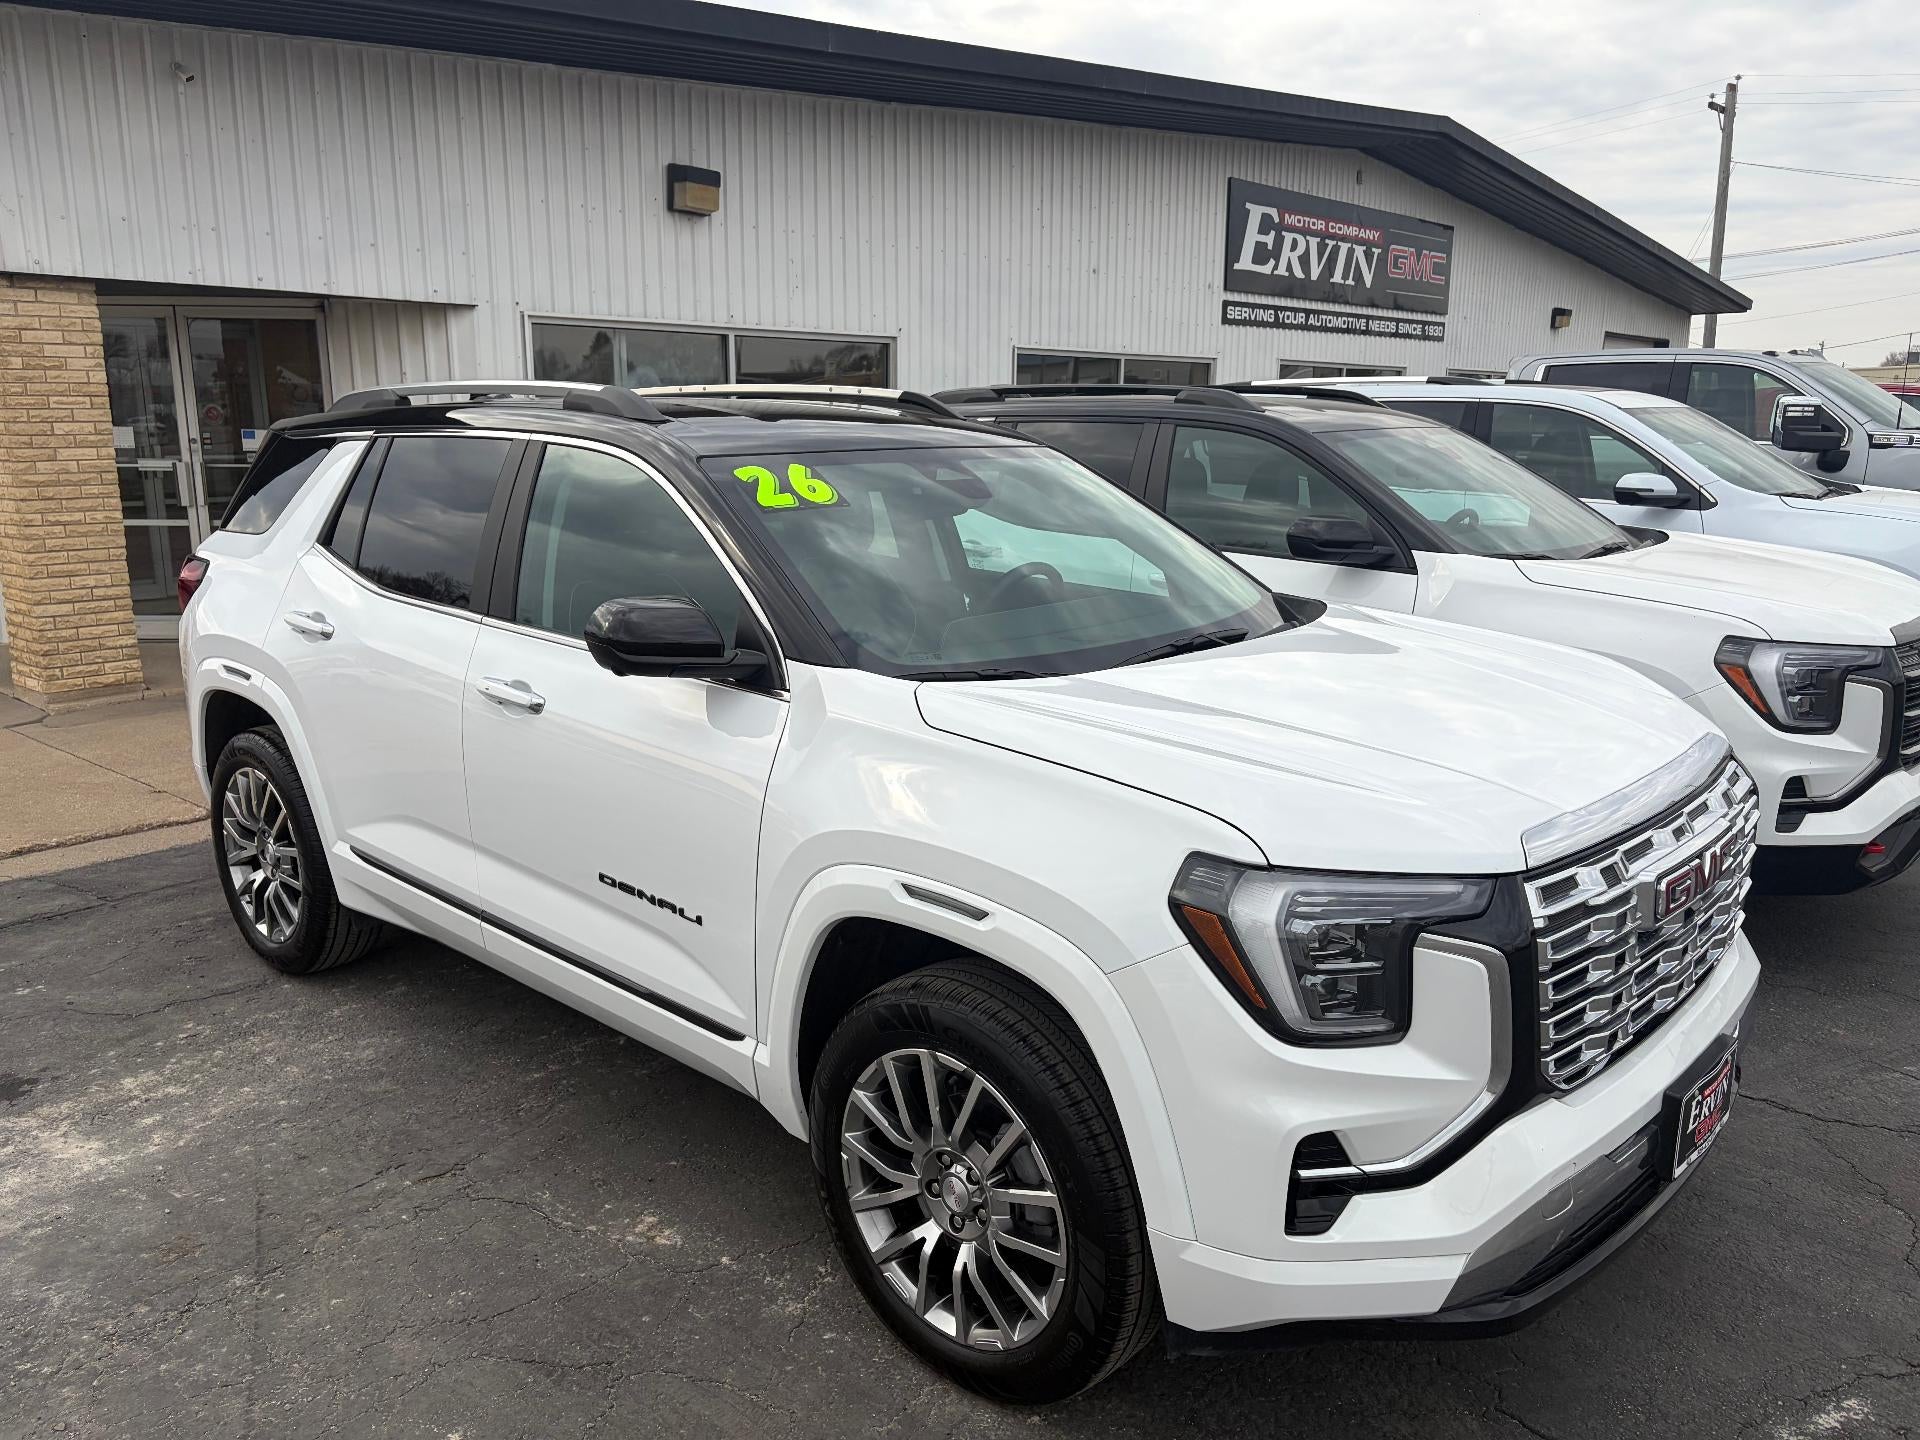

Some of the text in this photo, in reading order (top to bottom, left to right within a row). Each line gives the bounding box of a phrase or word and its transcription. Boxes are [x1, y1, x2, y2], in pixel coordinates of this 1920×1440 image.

[1233, 202, 1381, 288] ERVIN
[1284, 213, 1380, 241] MOTOR COMPANY
[1387, 244, 1447, 284] GMC
[1226, 306, 1444, 337] SERVING YOUR AUTOMOTIVE NEEDS SINCE 1930
[733, 463, 839, 509] 26
[1659, 832, 1737, 917] GMC
[598, 871, 703, 926] DENALI
